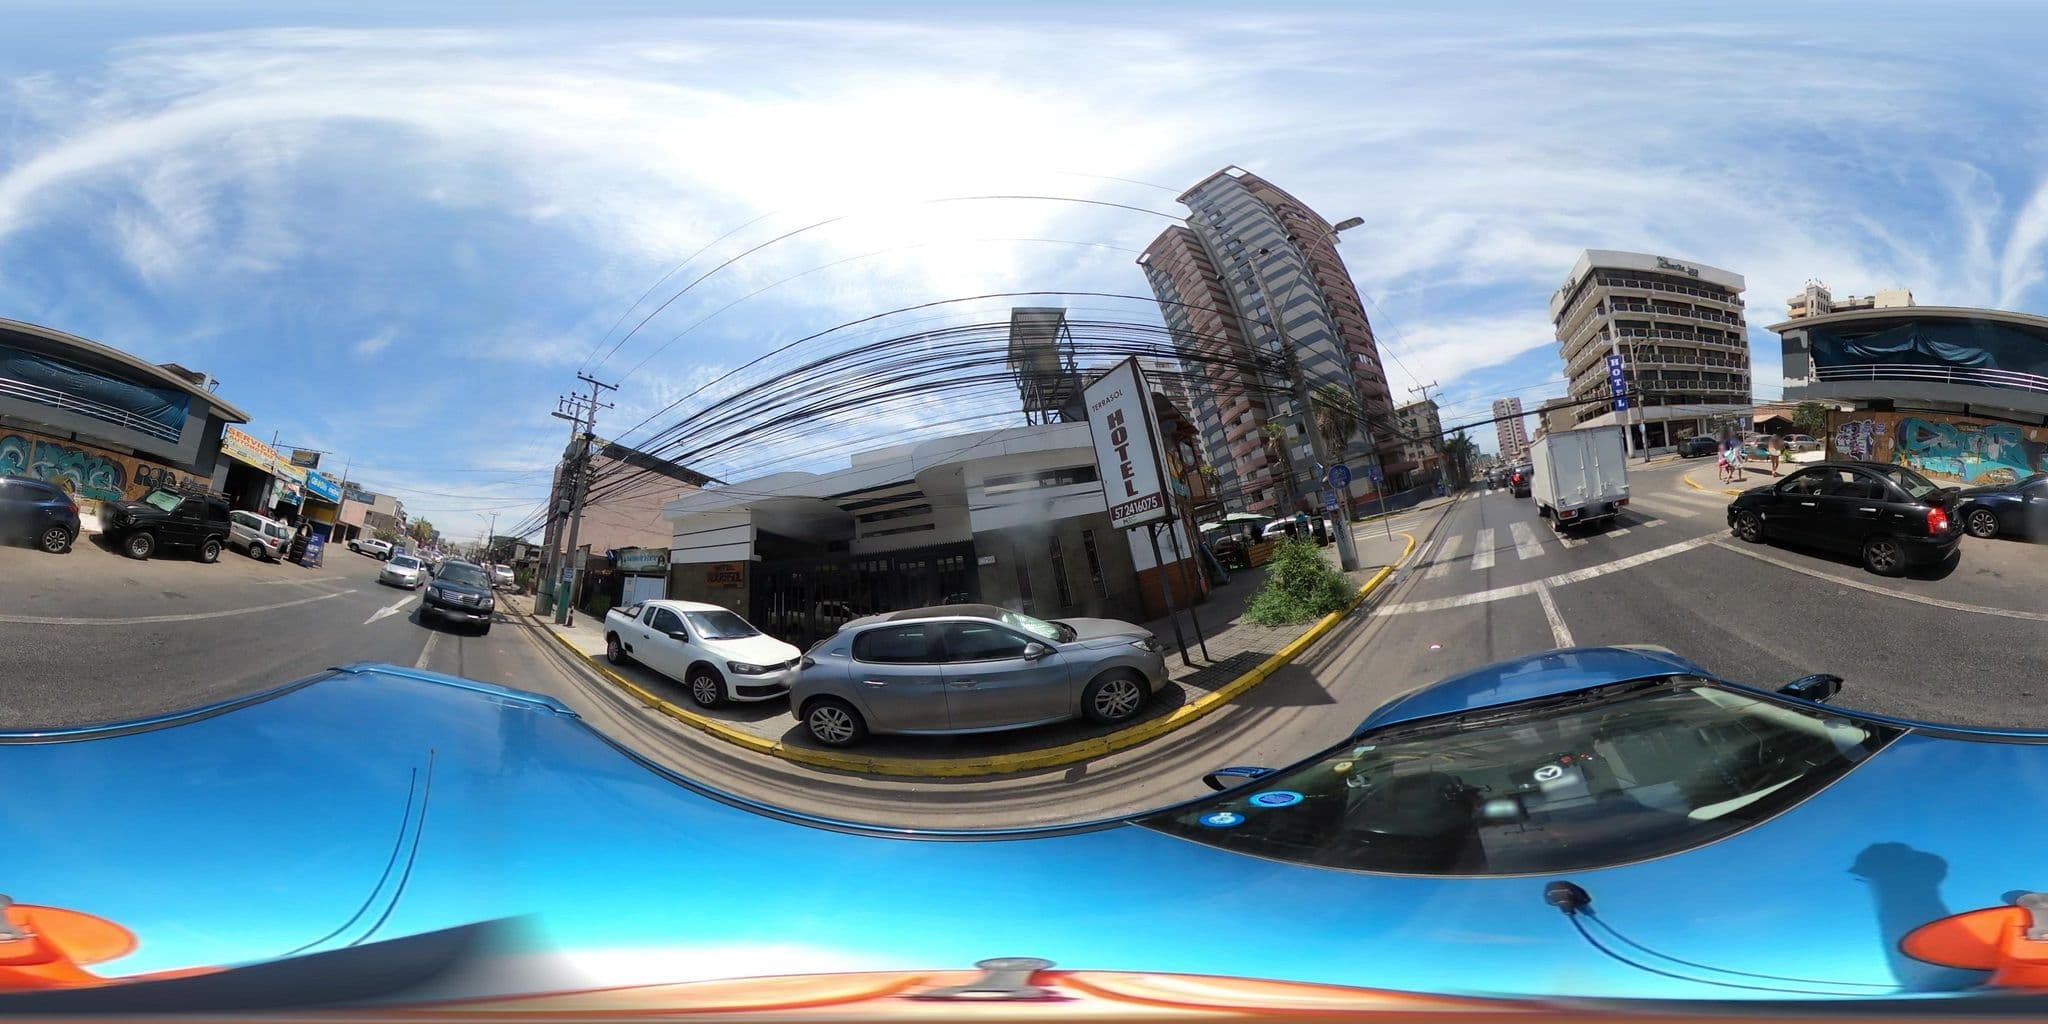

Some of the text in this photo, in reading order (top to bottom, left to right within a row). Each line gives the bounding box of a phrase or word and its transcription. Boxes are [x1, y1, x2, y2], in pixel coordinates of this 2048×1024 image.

[1610, 358, 1625, 407] HOTEL
[1092, 389, 1123, 412] TERRASOL
[228, 427, 277, 457] SERVICIO
[1107, 408, 1139, 497] HOTEL
[1114, 496, 1158, 519] 57 2416075
